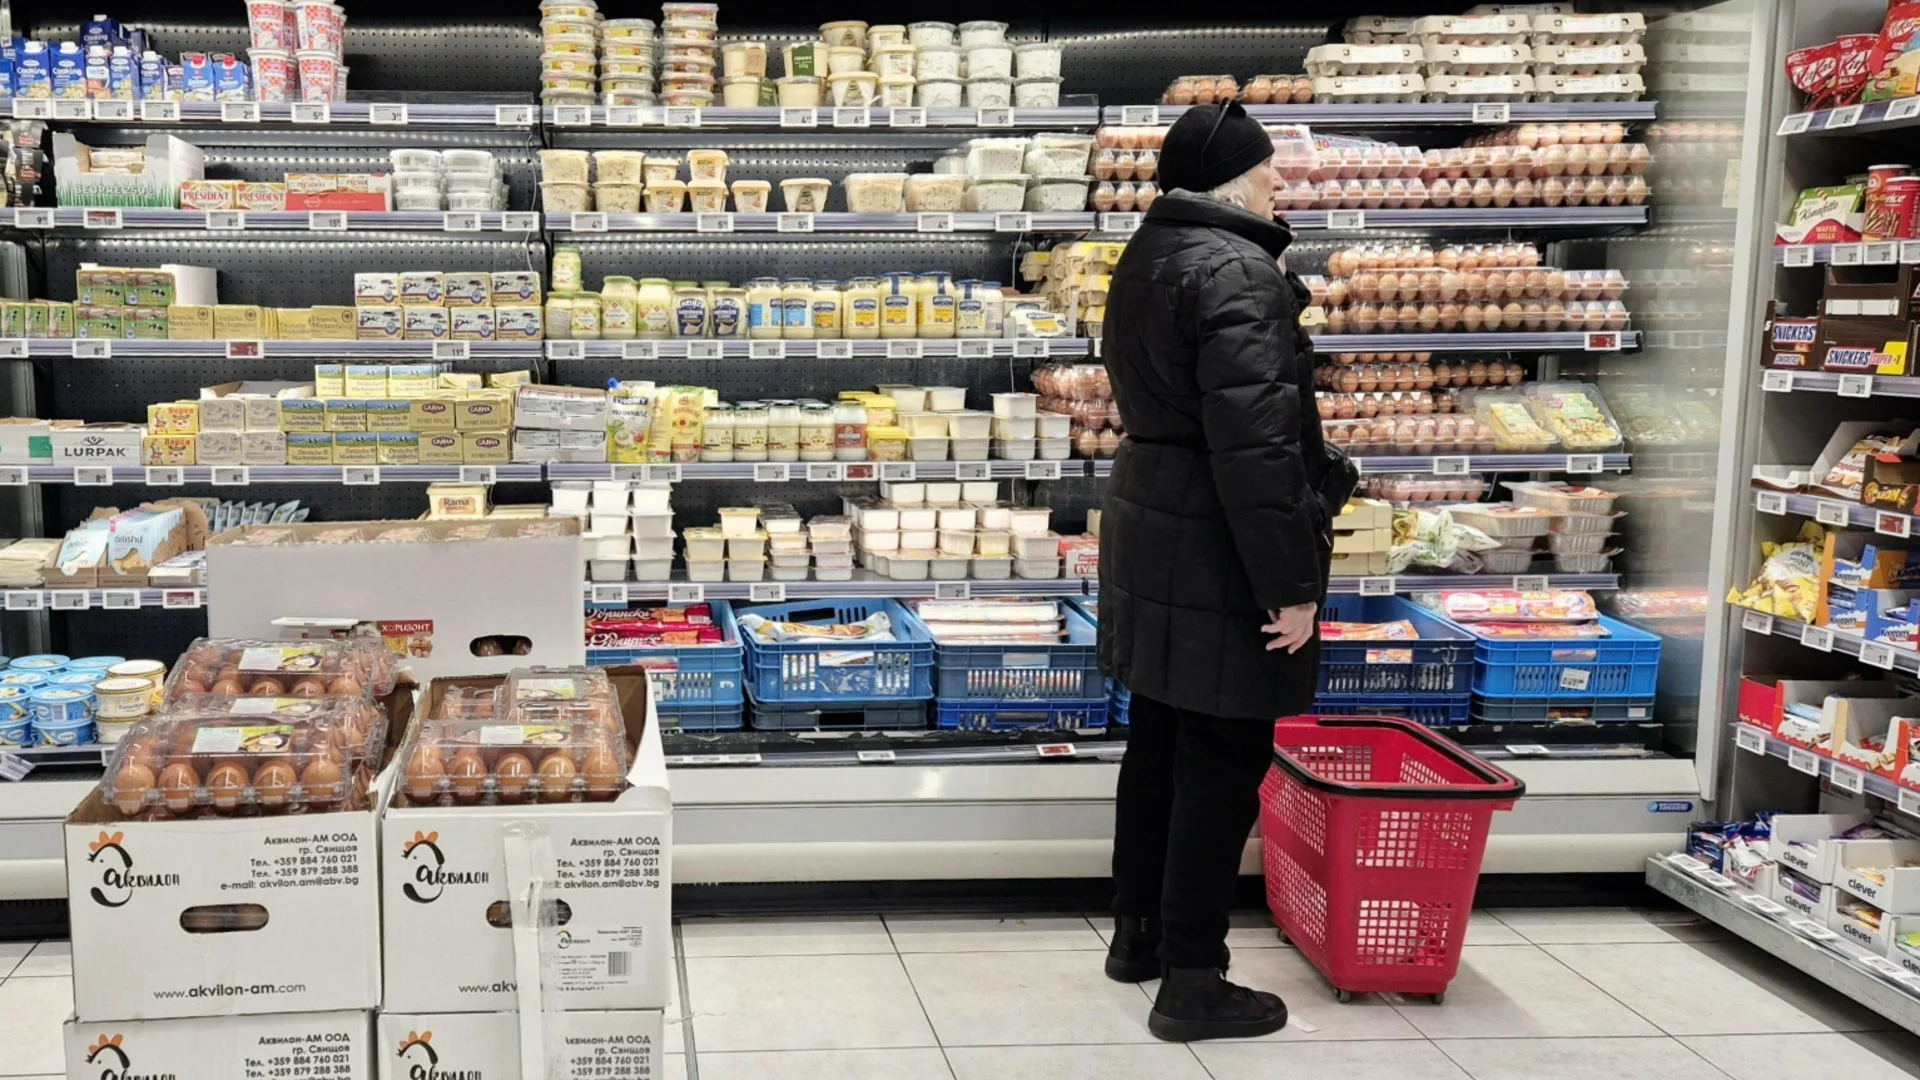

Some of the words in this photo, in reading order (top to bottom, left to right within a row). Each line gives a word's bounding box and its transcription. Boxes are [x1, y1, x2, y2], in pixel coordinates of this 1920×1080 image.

[17, 67, 47, 76] Cooking
[53, 67, 82, 76] Cooking
[1793, 57, 1837, 89] KitKat
[1772, 325, 1817, 343] SNICKERS
[1827, 350, 1872, 367] SNICKERS
[64, 447, 126, 457] LURPAK
[443, 498, 470, 507] Rama
[1834, 571, 1862, 582] Knoppers
[1881, 629, 1910, 641] Knoppers
[264, 834, 329, 845] Аквилон-АМ
[332, 833, 358, 842] ООД
[570, 837, 633, 846] Аквилон-АМ
[635, 837, 660, 845] ООД
[298, 847, 313, 855] гр.
[315, 845, 358, 853] Свищов
[603, 850, 617, 858] гр.
[619, 848, 660, 856] Свищов
[250, 858, 271, 867] Тел.
[273, 857, 297, 866] +359
[300, 856, 318, 865] 884
[321, 855, 338, 864] 760
[340, 854, 357, 863] 021
[557, 859, 576, 868] Тел.
[579, 859, 601, 868] +359
[604, 858, 621, 867] 884
[623, 858, 640, 867] 760
[642, 857, 659, 866] 021
[251, 869, 271, 878] Тел.
[274, 868, 298, 877] +359
[300, 867, 318, 876] 879
[320, 866, 338, 875] 288
[340, 865, 359, 874] 388
[557, 870, 576, 878] Тел.
[579, 869, 601, 878] +359
[604, 869, 621, 878] 879
[624, 868, 640, 877] 288
[642, 868, 660, 876] 388
[220, 881, 257, 890] e-mail:
[259, 876, 359, 889] akvilon.am@abv.bg
[153, 983, 307, 999] www.akvilon-am.com
[259, 1035, 322, 1045] Аквилон-АМ
[324, 1033, 350, 1042] ООД
[626, 1035, 651, 1044] ООД
[292, 1047, 306, 1055] гр.
[308, 1045, 350, 1054] Свищов
[594, 1048, 607, 1056] гр.
[610, 1046, 651, 1054] Свищов
[244, 1058, 265, 1067] Тел.
[267, 1057, 291, 1066] +359
[293, 1056, 311, 1065] 884
[313, 1055, 331, 1064] 760
[333, 1054, 350, 1063] 021
[570, 1057, 593, 1066] +359
[595, 1056, 612, 1065] 884
[615, 1056, 632, 1065] 760
[633, 1055, 650, 1064] 021
[245, 1069, 265, 1078] Тел.
[268, 1067, 291, 1077] +359
[293, 1067, 311, 1076] 879
[314, 1066, 331, 1075] 288
[333, 1065, 351, 1074] 388
[570, 1067, 593, 1076] +359
[595, 1067, 612, 1076] 879
[614, 1066, 632, 1075] 288
[633, 1066, 651, 1075] 388
